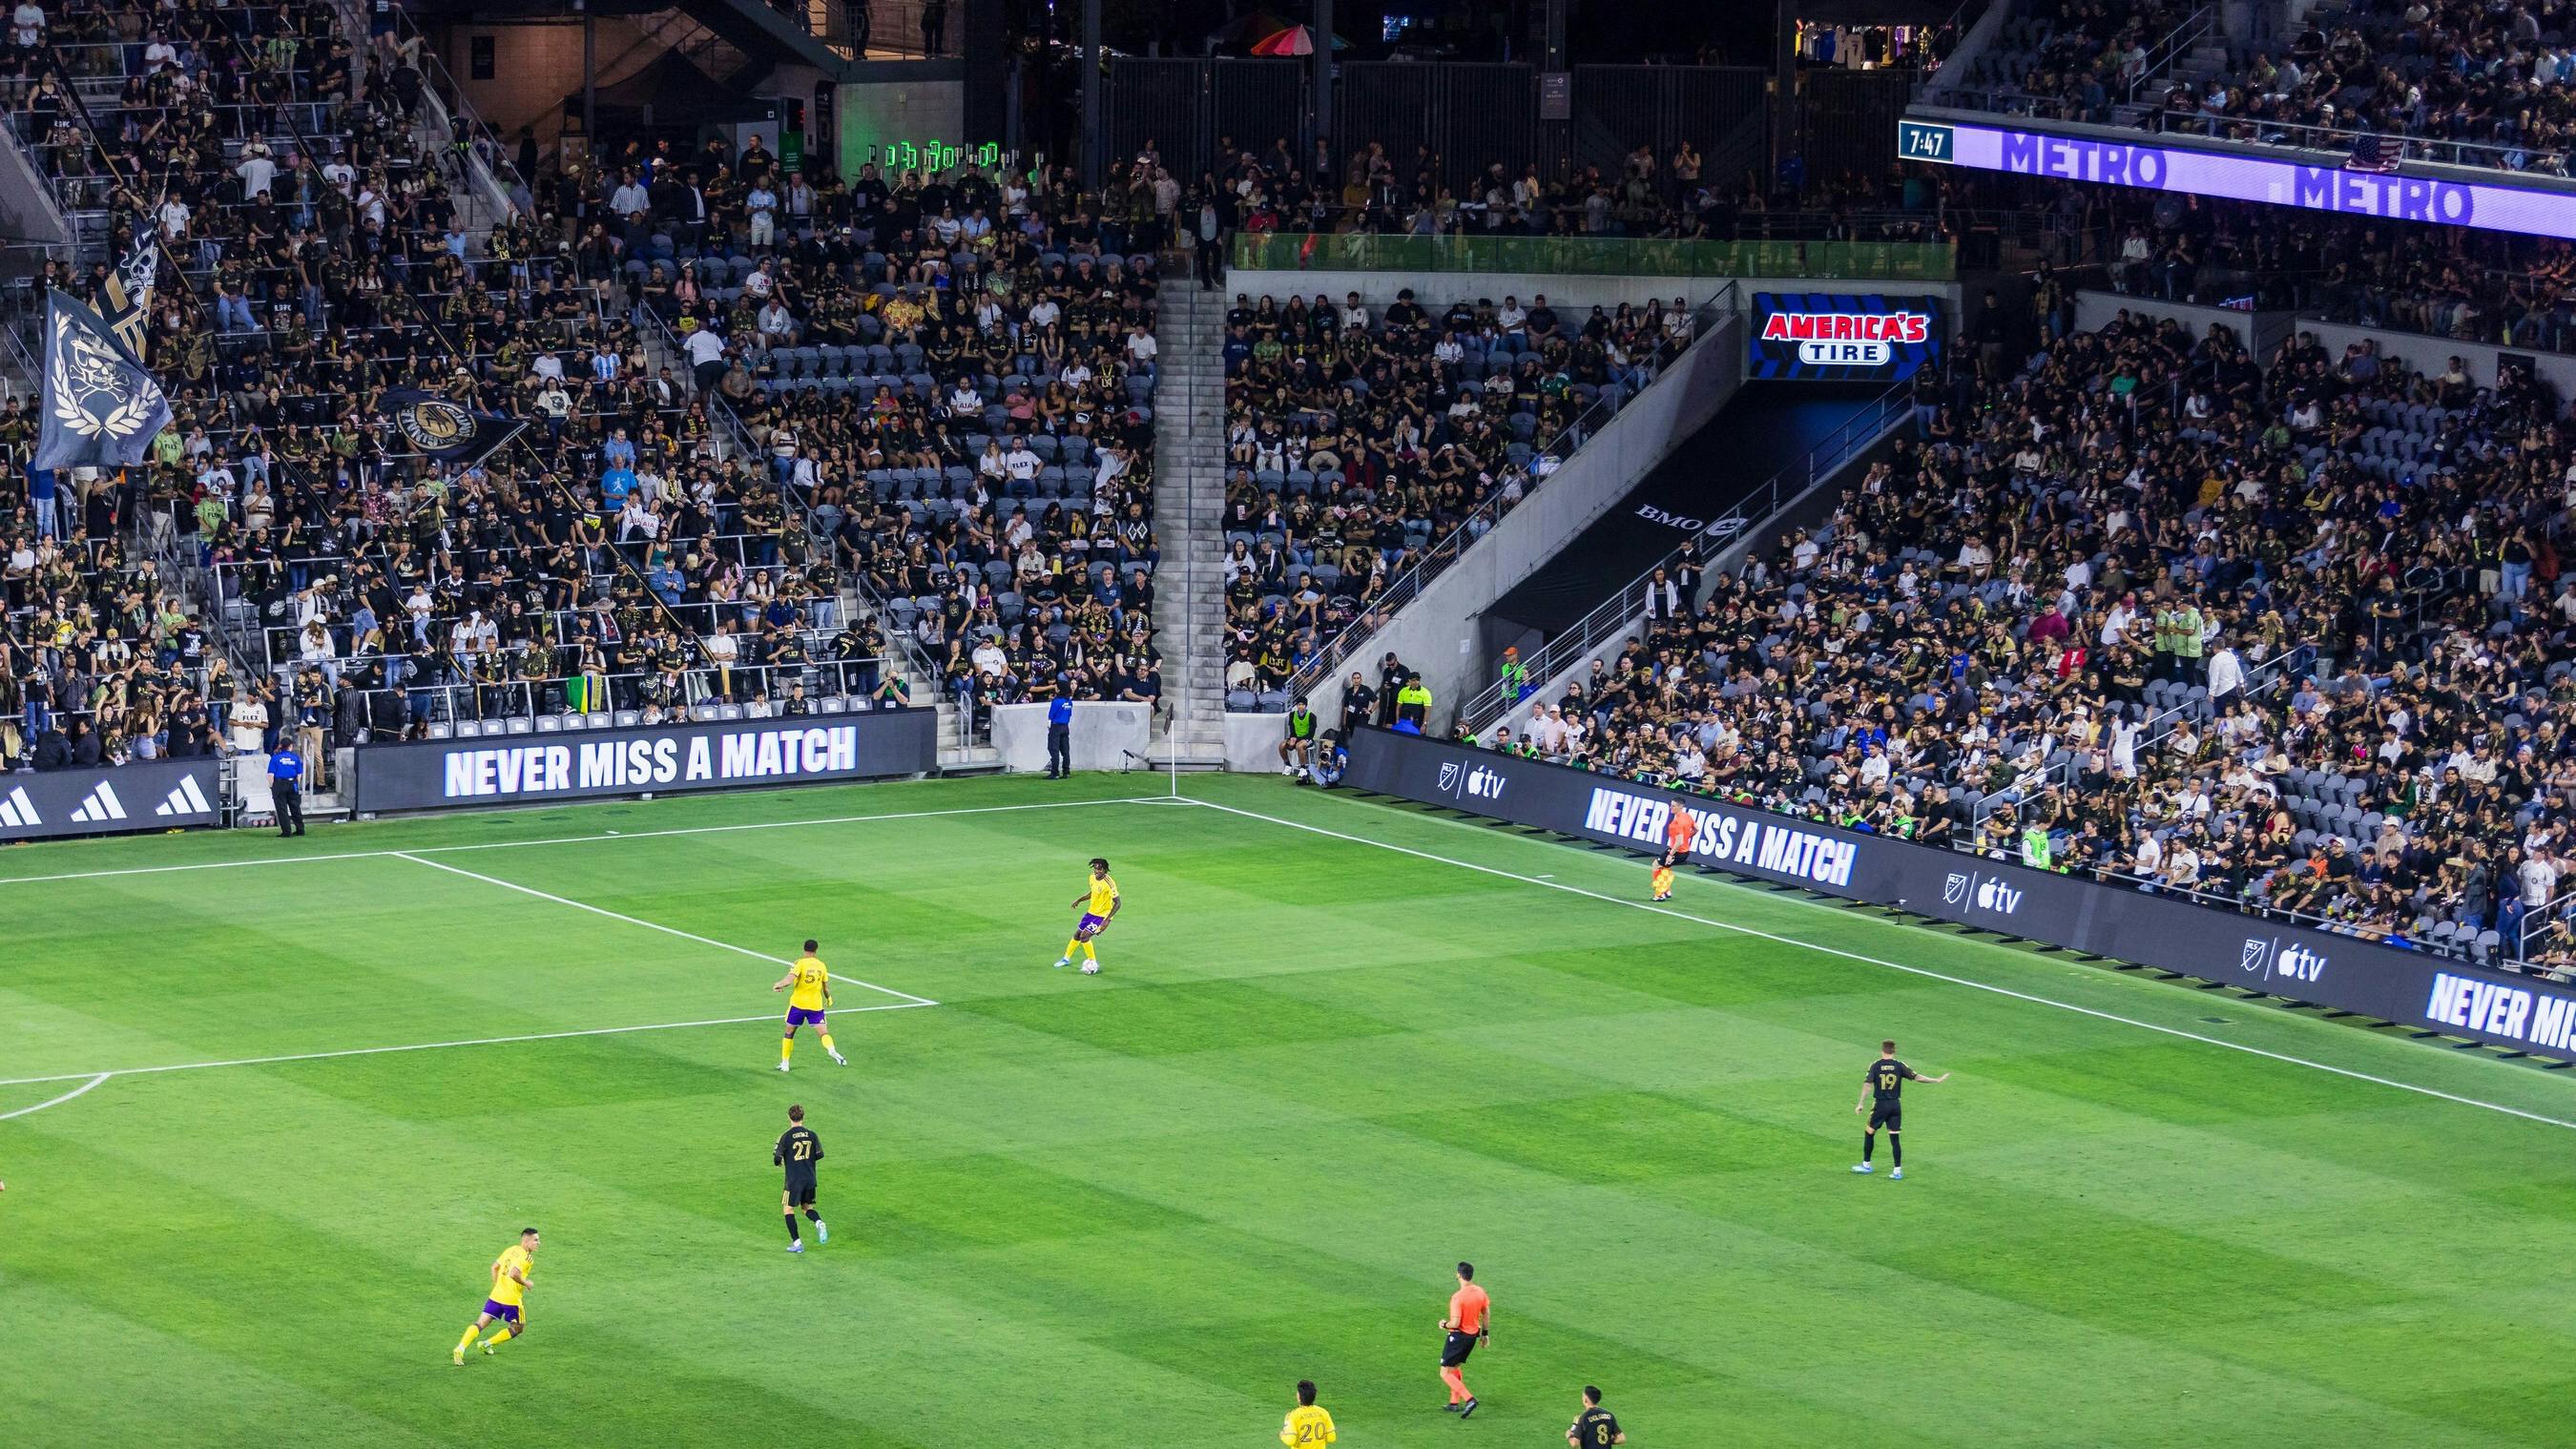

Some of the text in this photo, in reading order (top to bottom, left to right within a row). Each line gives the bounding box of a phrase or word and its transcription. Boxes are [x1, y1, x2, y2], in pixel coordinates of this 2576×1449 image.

[1910, 131, 1944, 155] 7:47
[2002, 132, 2167, 189] METRO
[2294, 165, 2473, 226] METRO
[1762, 312, 1927, 343] AMERICA'S
[1810, 345, 1878, 361] TIRE
[1012, 461, 1028, 469] FLEX
[1634, 504, 1703, 530] BMO
[445, 726, 857, 797] NEVER MISS A MATCH
[1483, 770, 1506, 799] tv
[1585, 788, 1669, 845] NEVER
[1734, 821, 1759, 864] A
[1757, 825, 1858, 886] MATCH
[1995, 882, 2022, 914] tv
[1087, 921, 1098, 932] 29
[2297, 948, 2327, 982] tv
[2426, 973, 2532, 1040] NEVER
[1880, 1074, 1898, 1090] 19
[793, 1141, 812, 1161] 27
[1299, 1421, 1326, 1442] 20
[1596, 1423, 1609, 1445] 8
